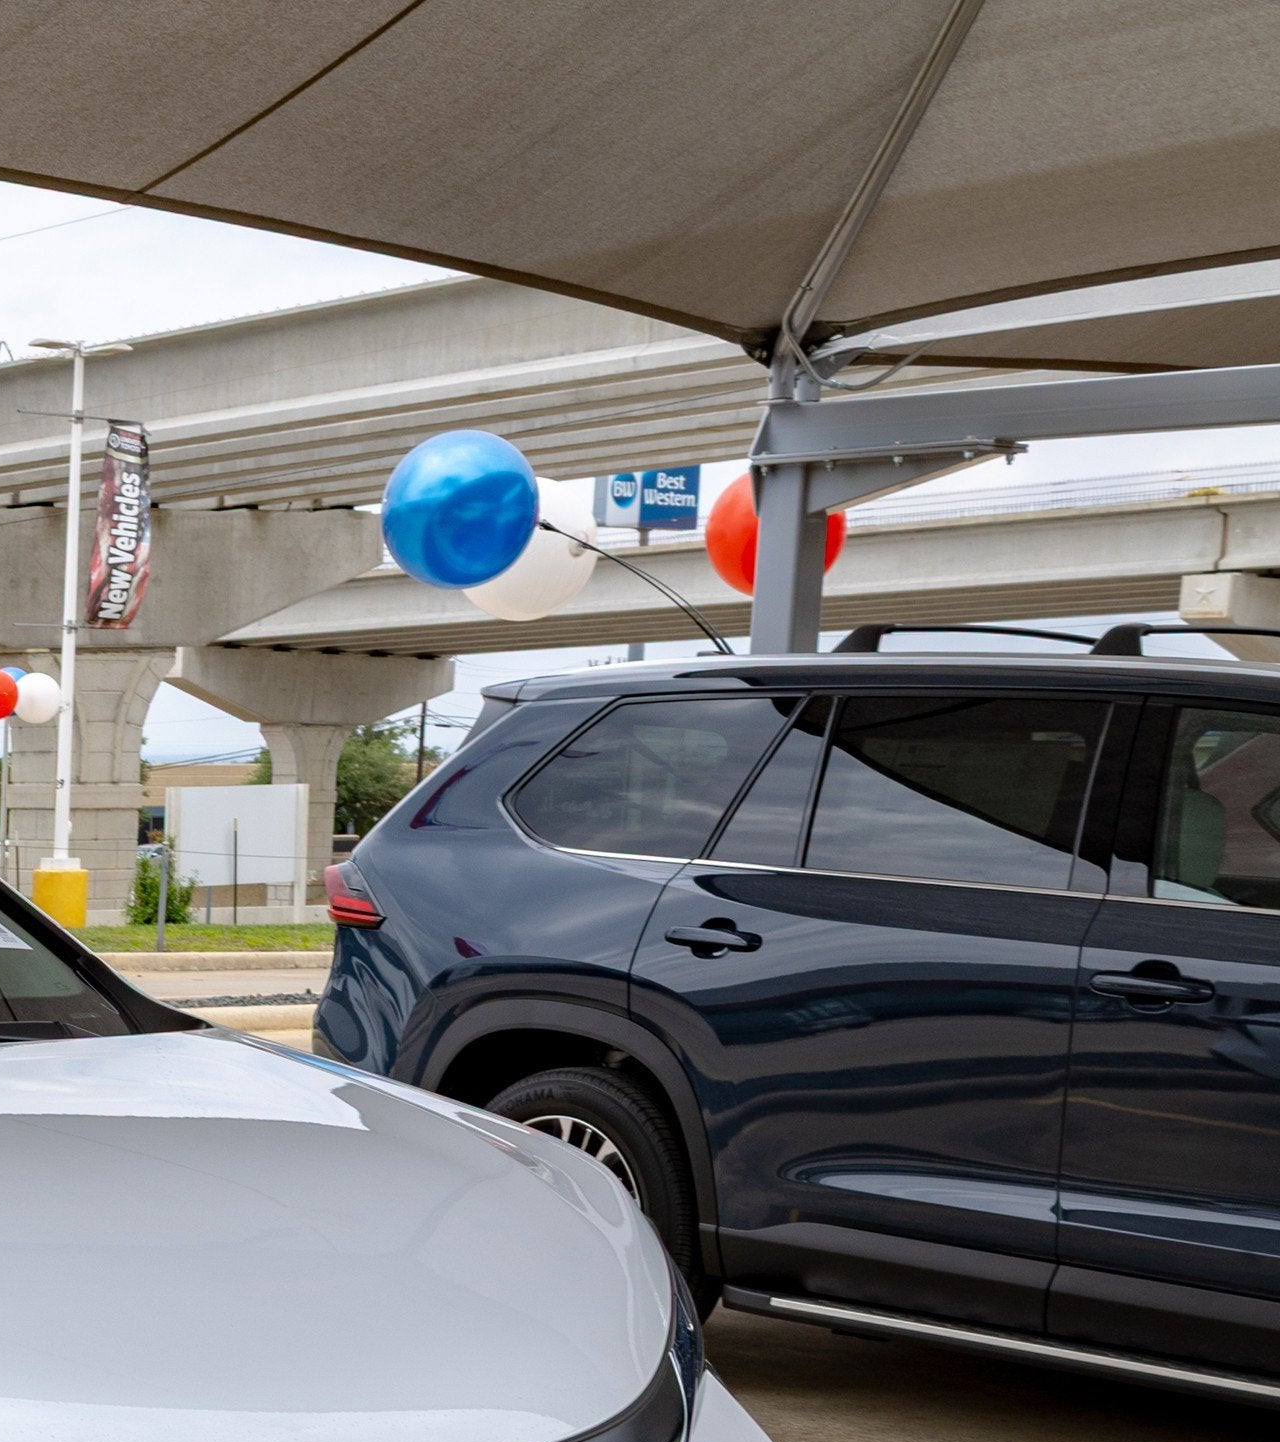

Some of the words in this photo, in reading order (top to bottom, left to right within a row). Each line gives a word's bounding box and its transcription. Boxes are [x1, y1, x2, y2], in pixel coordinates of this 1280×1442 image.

[613, 480, 635, 498] BW
[656, 472, 687, 490] Best
[643, 488, 697, 508] Western
[107, 471, 141, 566] Vehicles
[97, 568, 134, 621] New
